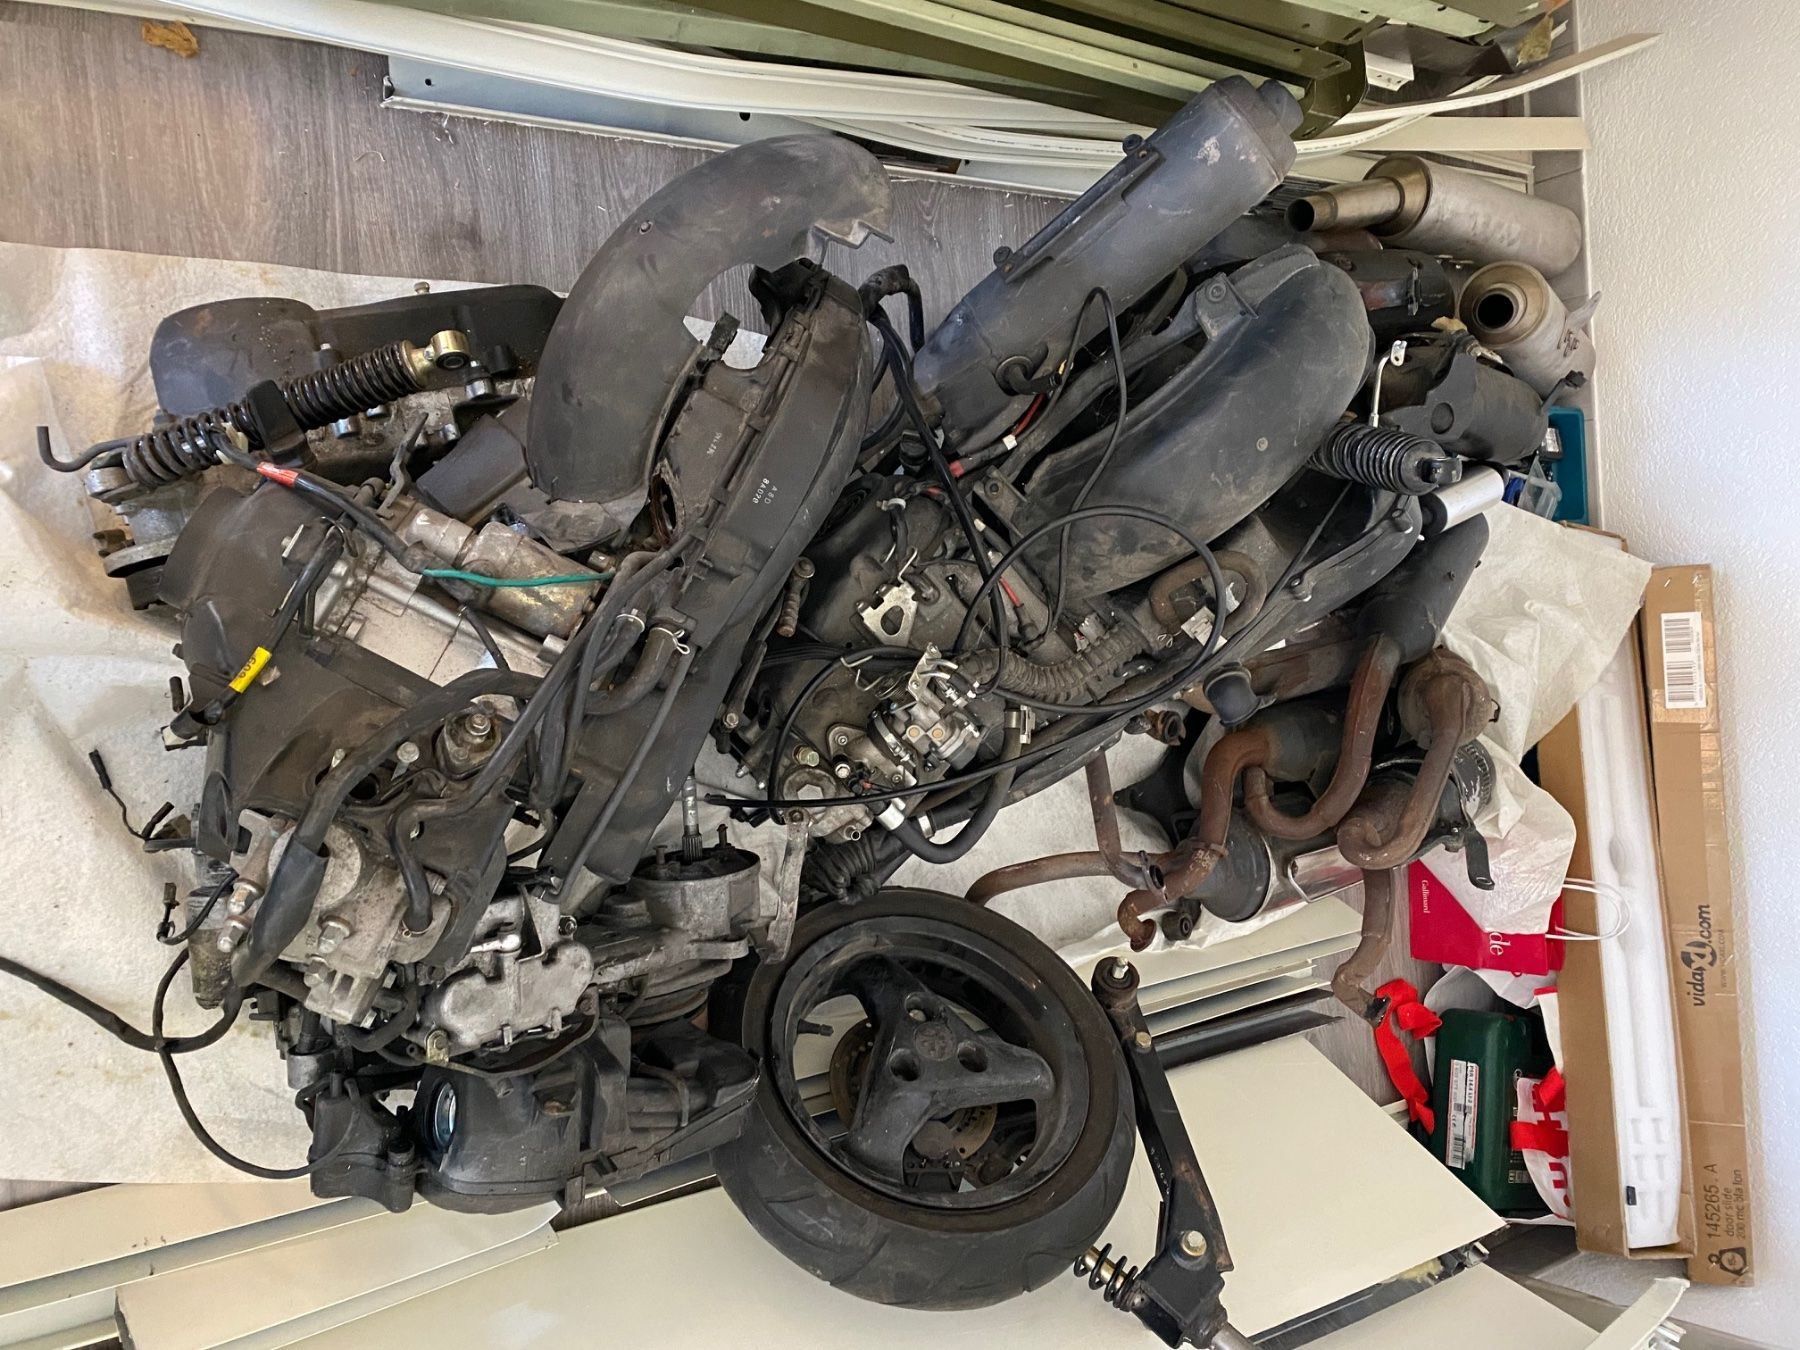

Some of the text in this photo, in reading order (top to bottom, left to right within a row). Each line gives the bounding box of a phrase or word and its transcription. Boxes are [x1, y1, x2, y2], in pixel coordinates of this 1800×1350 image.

[1421, 879, 1431, 914] Gallimard
[1722, 1187, 1735, 1237] door slide
